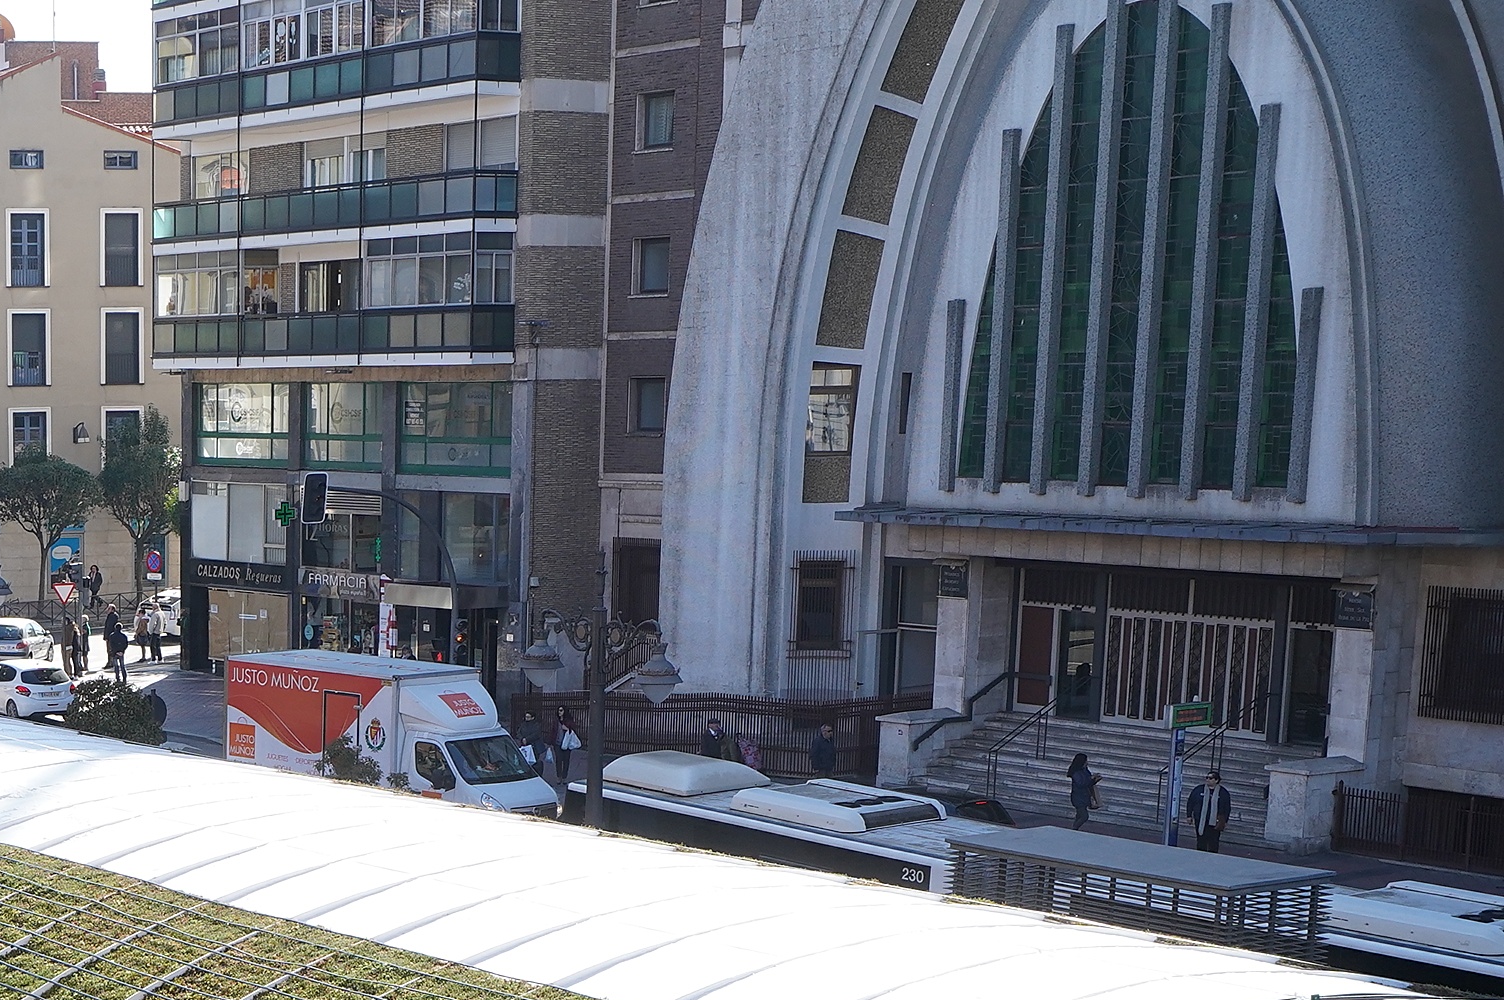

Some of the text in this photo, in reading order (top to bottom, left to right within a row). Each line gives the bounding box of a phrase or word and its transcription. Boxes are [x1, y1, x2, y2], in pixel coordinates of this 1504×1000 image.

[319, 523, 348, 534] HORAS
[197, 565, 282, 584] CALZADOS Regueras
[308, 572, 367, 588] FARMACIA
[230, 667, 320, 692] JUSTO MUÑOZ
[454, 706, 484, 716] MUÑOZ
[234, 734, 254, 744] JUSTO
[230, 744, 254, 756] MUÑOZ
[266, 753, 288, 762] JUGUETES
[902, 868, 924, 884] 230
